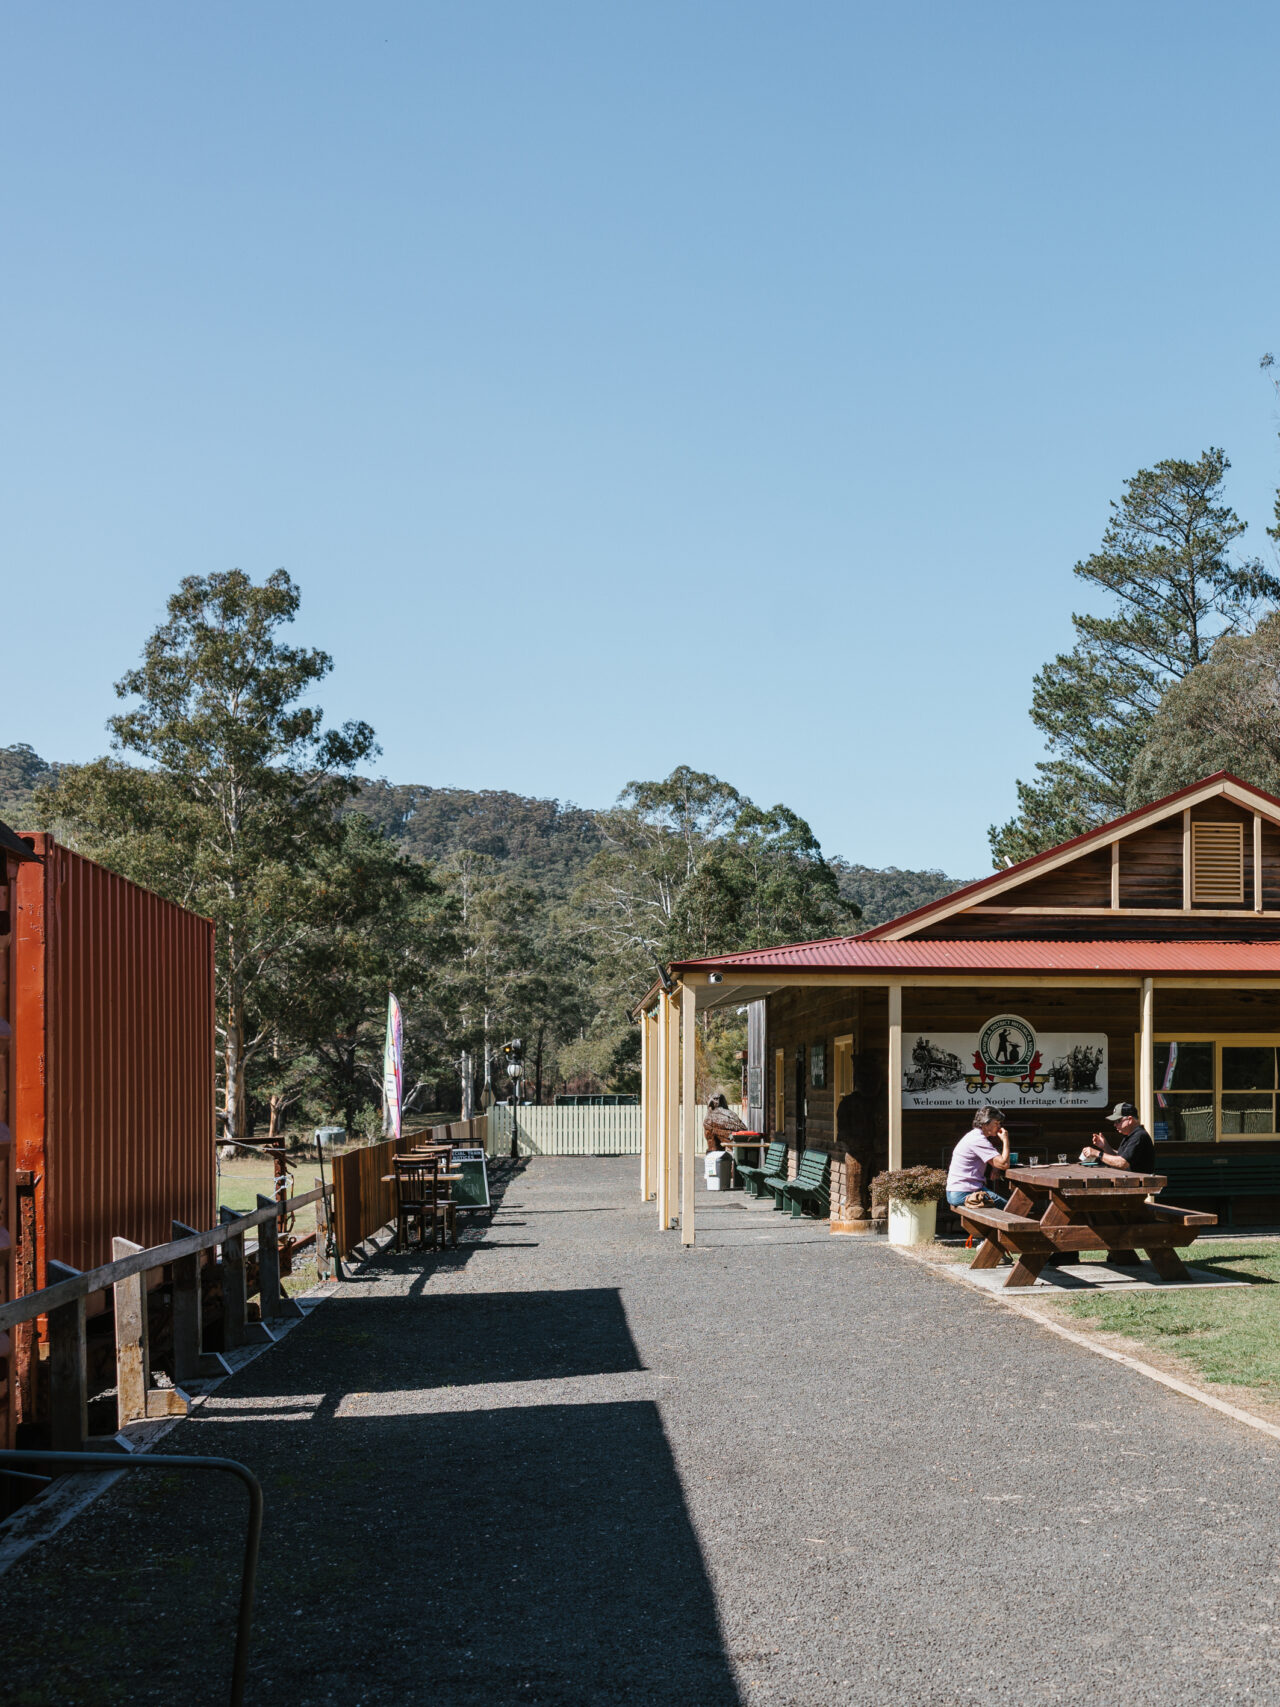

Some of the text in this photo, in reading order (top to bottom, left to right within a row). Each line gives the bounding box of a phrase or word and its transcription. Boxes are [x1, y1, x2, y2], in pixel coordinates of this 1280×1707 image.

[990, 1020, 1010, 1031] DISTRICT
[1011, 1021, 1033, 1041] HISTORICAL
[913, 1097, 1089, 1107] Welcome to the Noojee Heritage Centre
